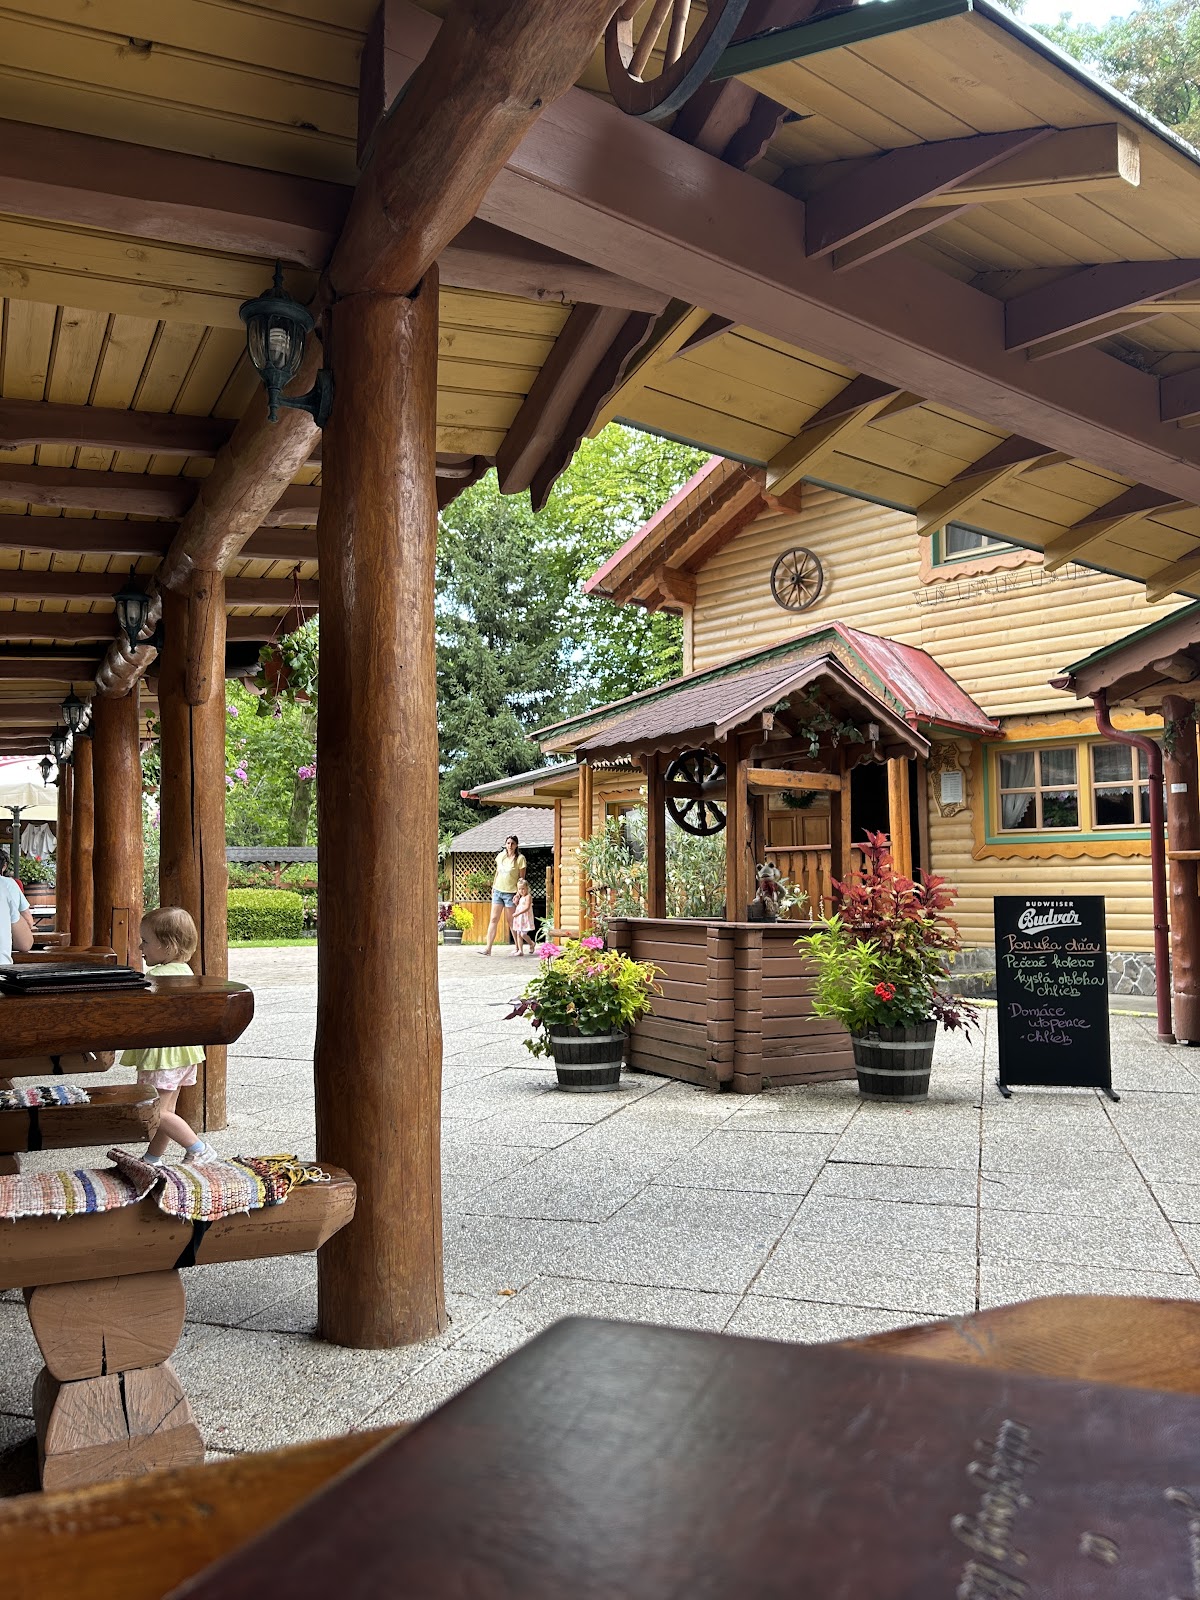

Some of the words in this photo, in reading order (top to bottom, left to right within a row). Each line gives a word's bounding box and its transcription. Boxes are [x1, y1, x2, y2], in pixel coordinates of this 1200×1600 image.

[1018, 908, 1082, 935] Budvar
[1002, 933, 1062, 953] Ponuka
[1002, 953, 1048, 968] Pečené
